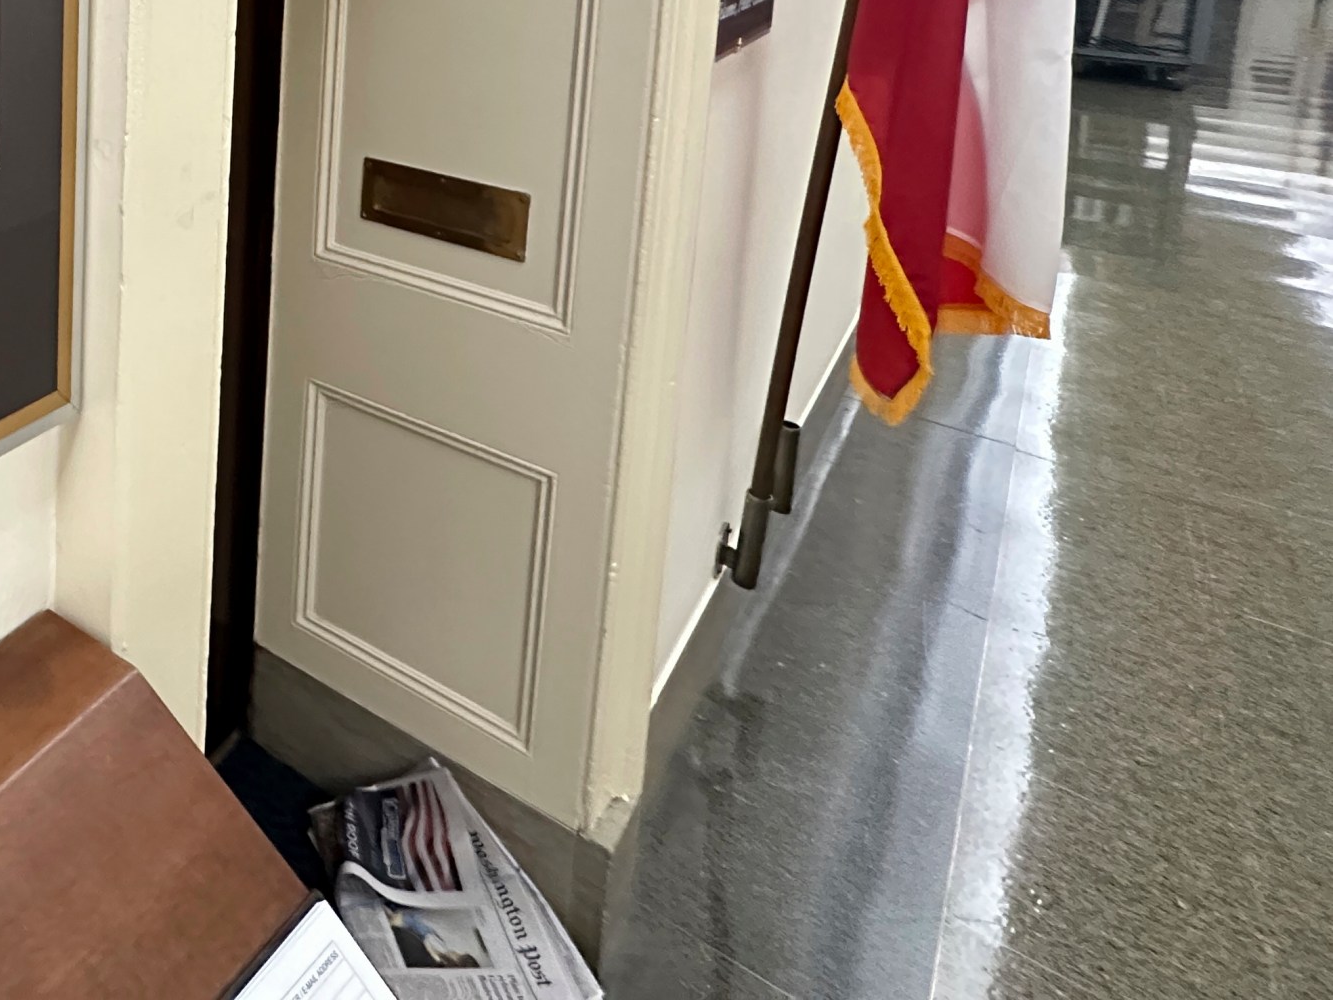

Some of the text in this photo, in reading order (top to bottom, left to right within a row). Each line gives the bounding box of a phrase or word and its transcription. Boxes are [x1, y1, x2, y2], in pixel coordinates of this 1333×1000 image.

[301, 974, 318, 995] E-MAIL
[316, 949, 339, 977] ADDRESS
[517, 943, 553, 987] Post
